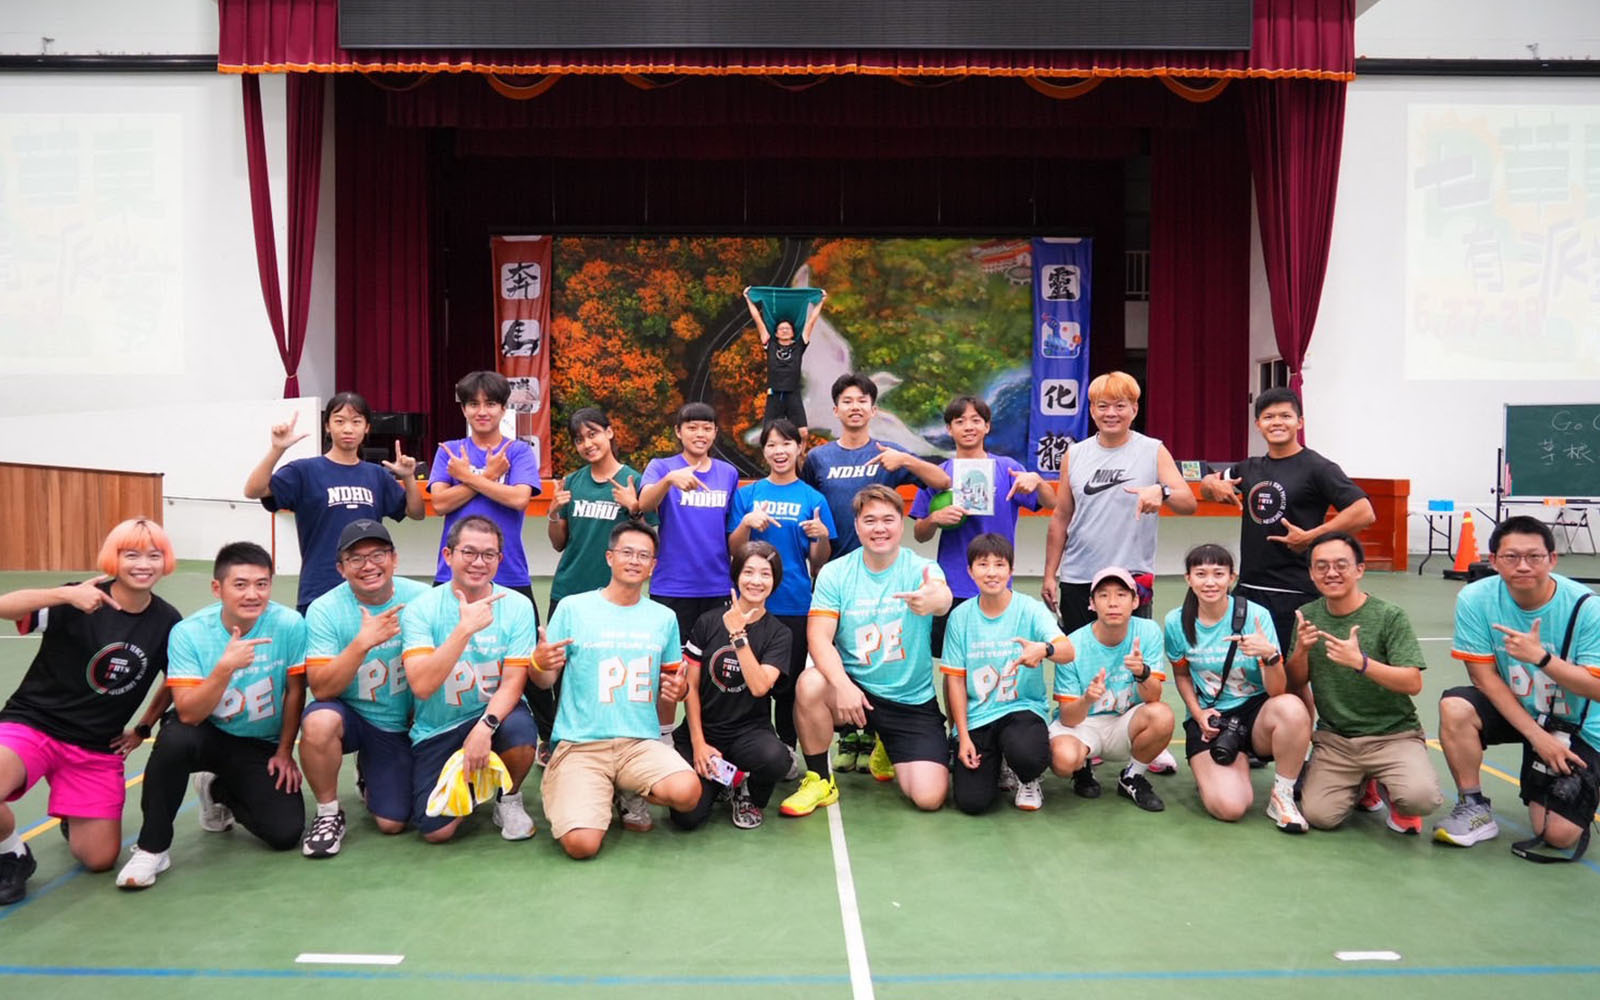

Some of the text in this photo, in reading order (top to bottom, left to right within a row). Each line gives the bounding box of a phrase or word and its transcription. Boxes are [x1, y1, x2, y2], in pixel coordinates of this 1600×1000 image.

[827, 464, 880, 479] NDHU
[1091, 469, 1126, 483] NIKE
[327, 486, 374, 504] NDHU
[680, 490, 727, 508] NDHU
[572, 499, 621, 520] NDHU
[753, 500, 802, 517] NDHU
[855, 618, 906, 667] PE
[441, 659, 503, 706] PE
[598, 655, 652, 703] PE
[973, 660, 1018, 704] PE
[212, 676, 276, 722] PE
